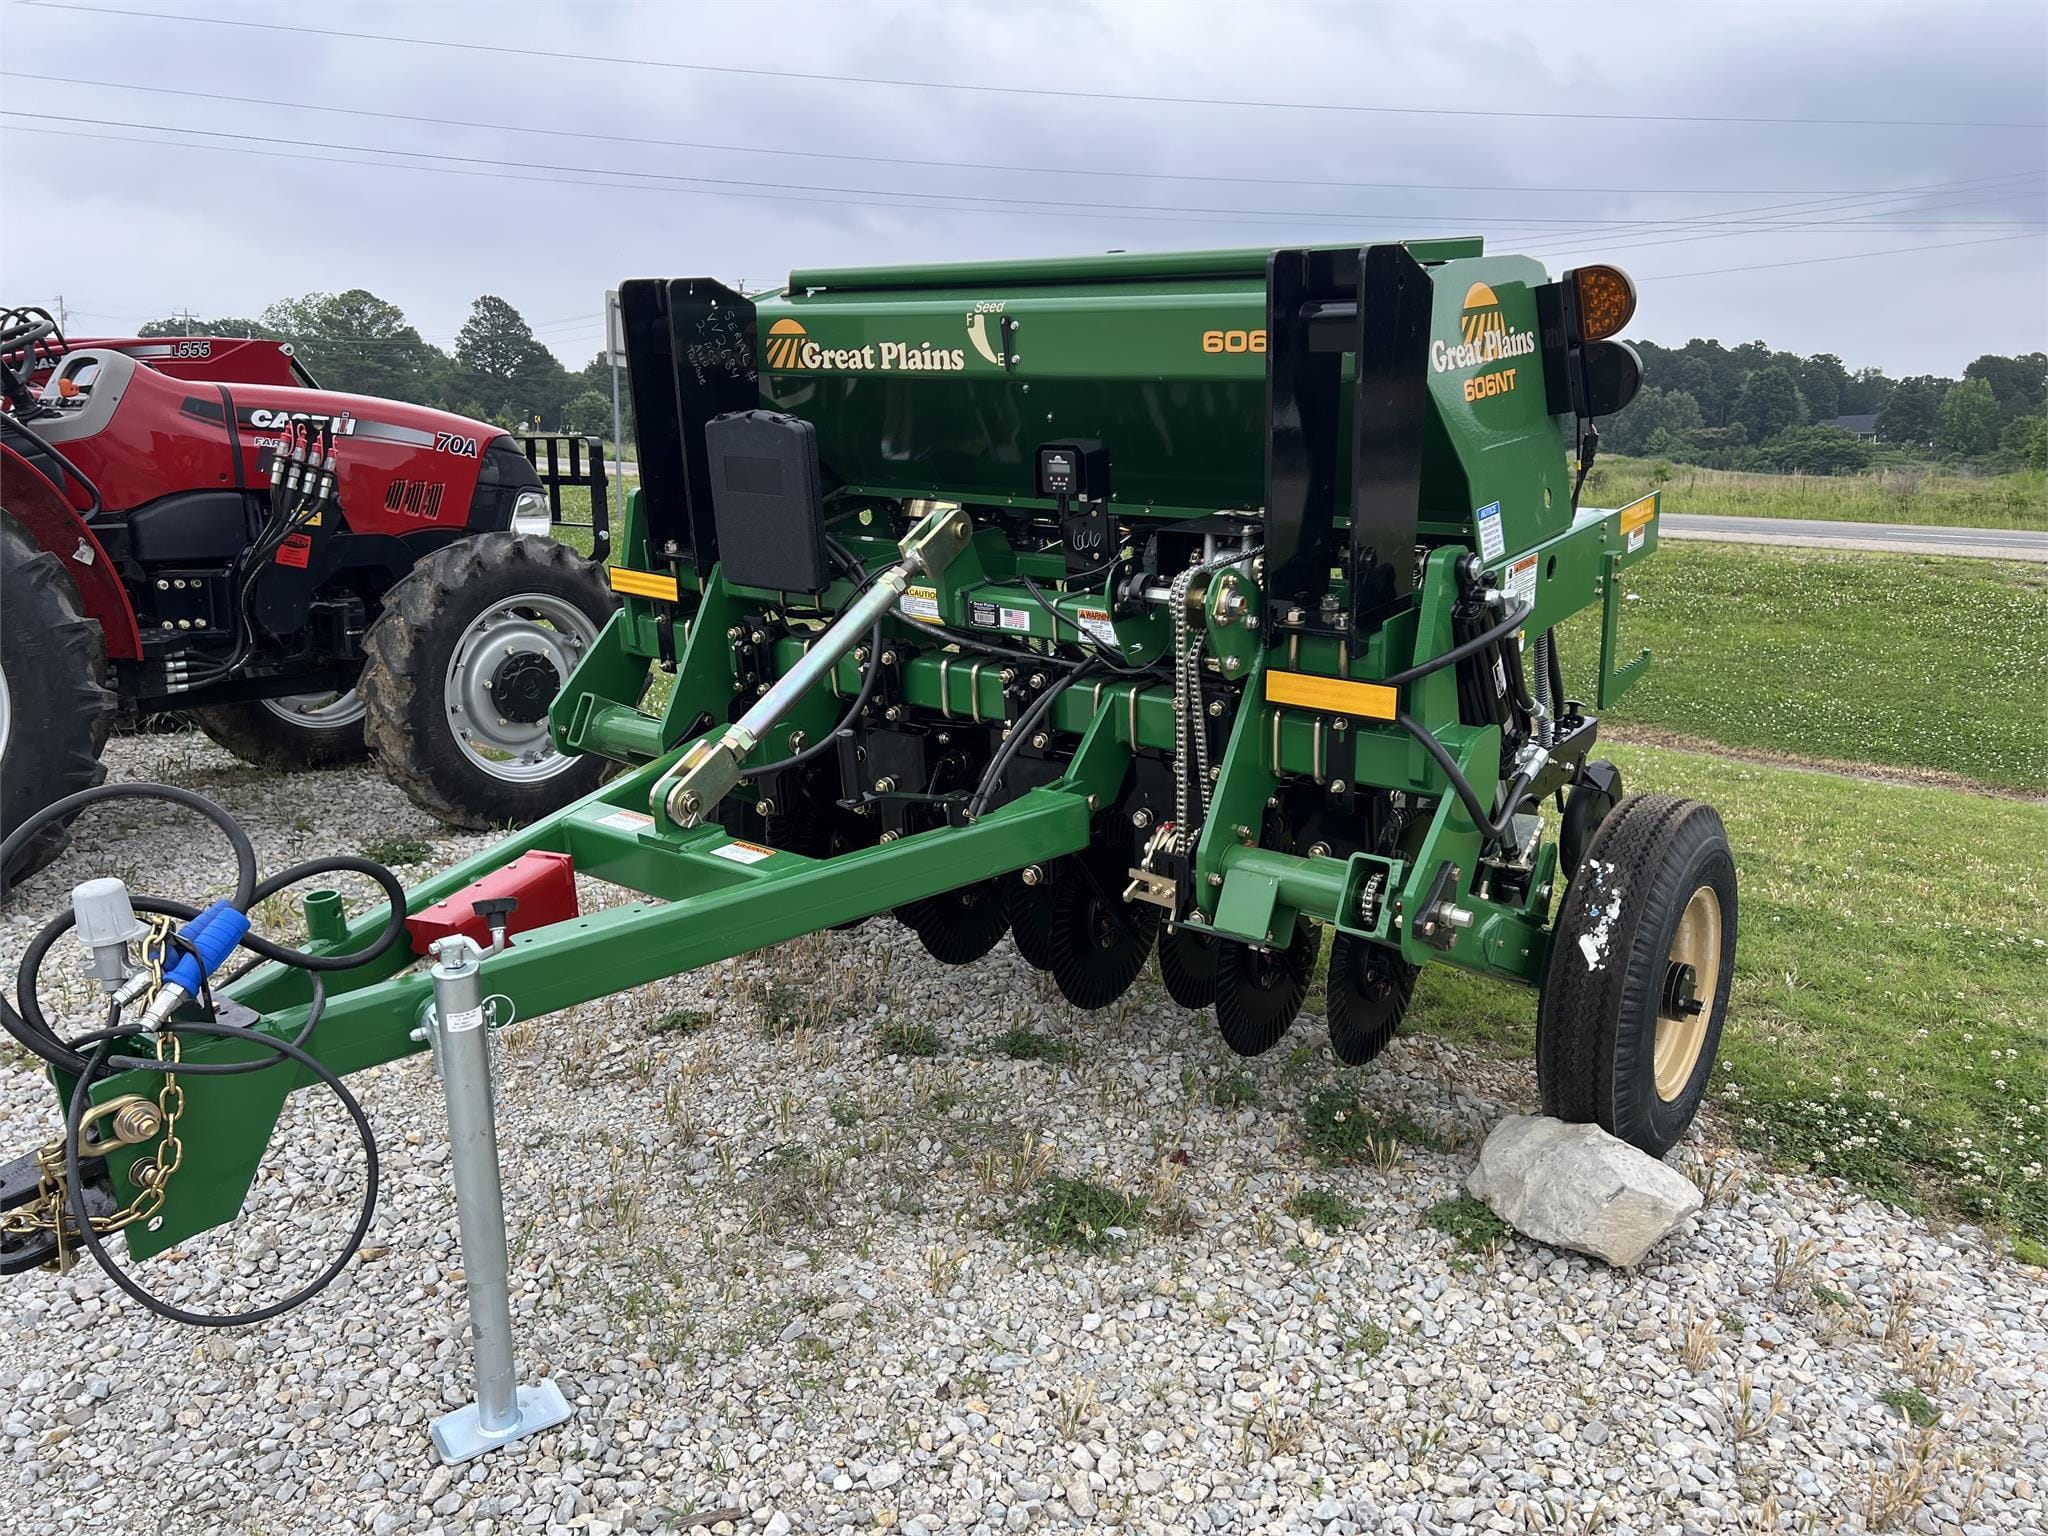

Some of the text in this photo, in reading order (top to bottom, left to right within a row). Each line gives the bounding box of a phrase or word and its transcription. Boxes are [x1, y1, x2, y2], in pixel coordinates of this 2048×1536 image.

[975, 301, 1006, 313] Seed
[966, 313, 973, 327] F
[724, 310, 750, 367] SERIAL
[170, 341, 211, 358] L555
[801, 341, 965, 371] Great Plains
[997, 353, 1005, 367] E
[1431, 326, 1535, 373] Great Plains
[1463, 368, 1517, 402] 606NT
[251, 409, 330, 430] CA
[436, 432, 478, 458] 70A
[909, 589, 936, 599] CAUTIO
